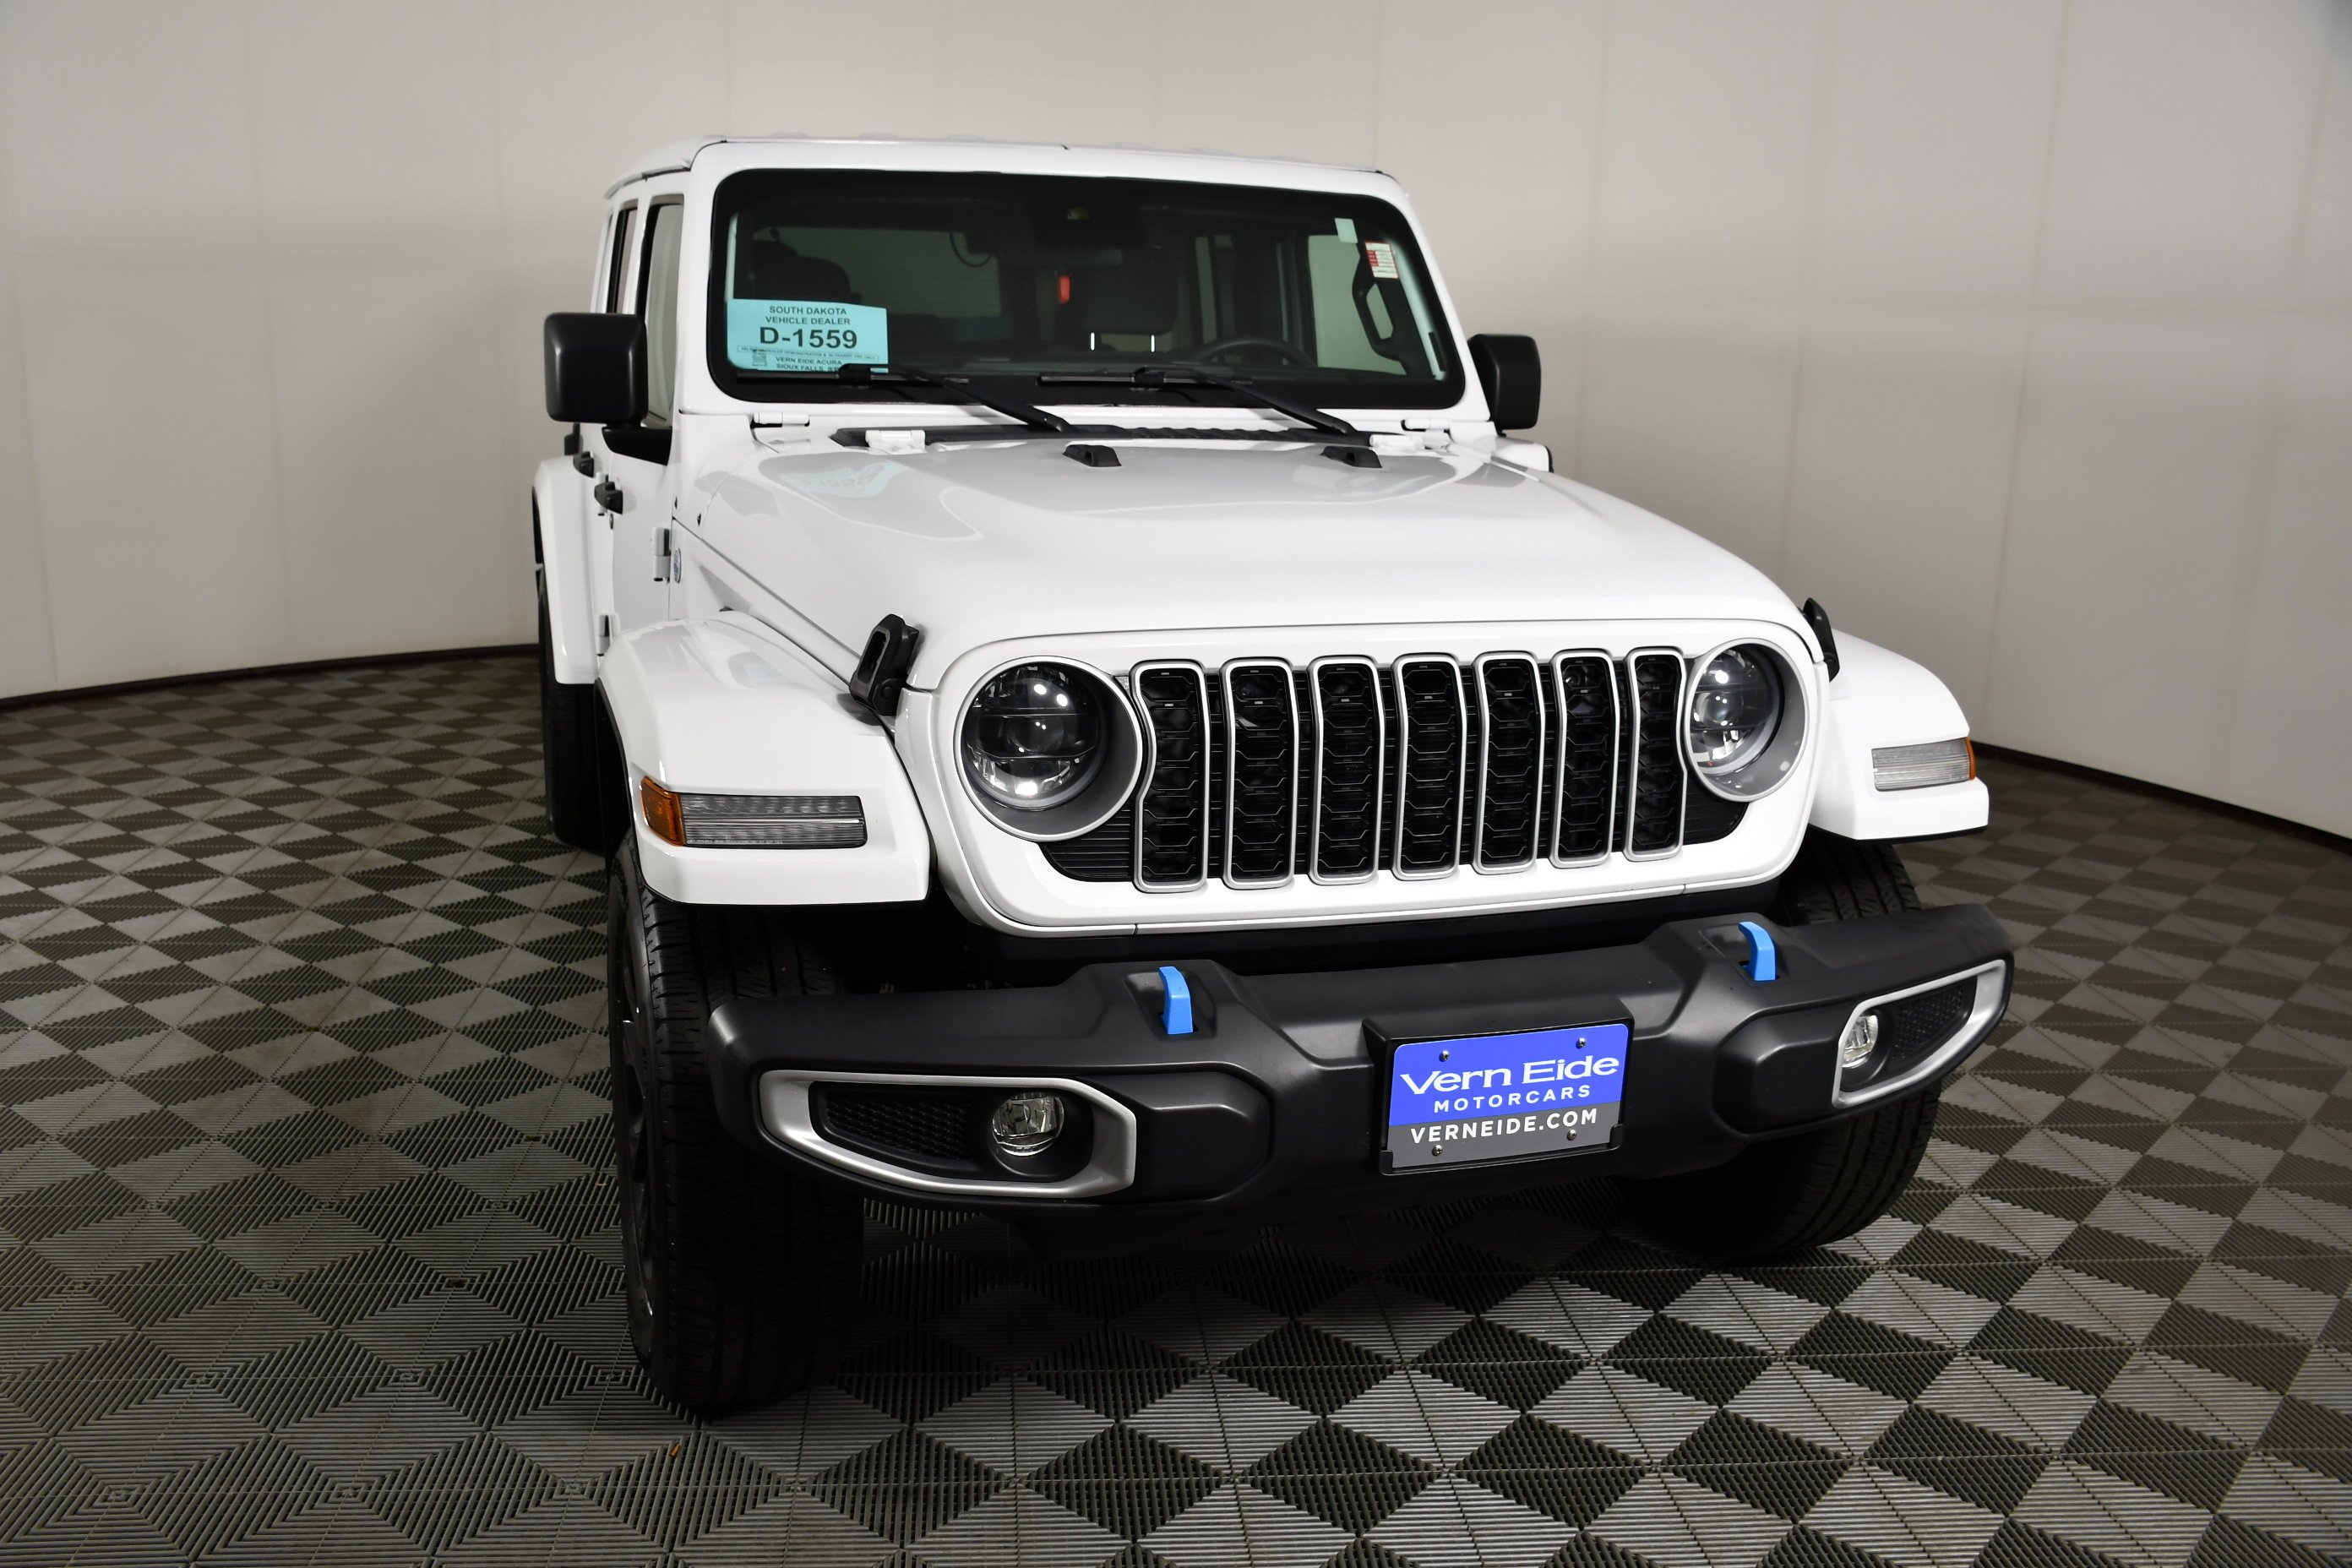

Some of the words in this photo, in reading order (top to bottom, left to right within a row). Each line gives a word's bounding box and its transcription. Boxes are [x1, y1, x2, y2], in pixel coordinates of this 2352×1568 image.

[765, 316, 808, 324] VEHICLE
[811, 317, 851, 325] DEALER
[770, 306, 804, 315] SOUTH
[807, 307, 847, 315] DAKOTA
[760, 326, 858, 349] D-1559
[1400, 1067, 1512, 1095] Vern
[1522, 1054, 1620, 1085] Eide
[1434, 1084, 1591, 1113] MOTORCARS
[1410, 1108, 1598, 1144] VERNEIDE.COM
